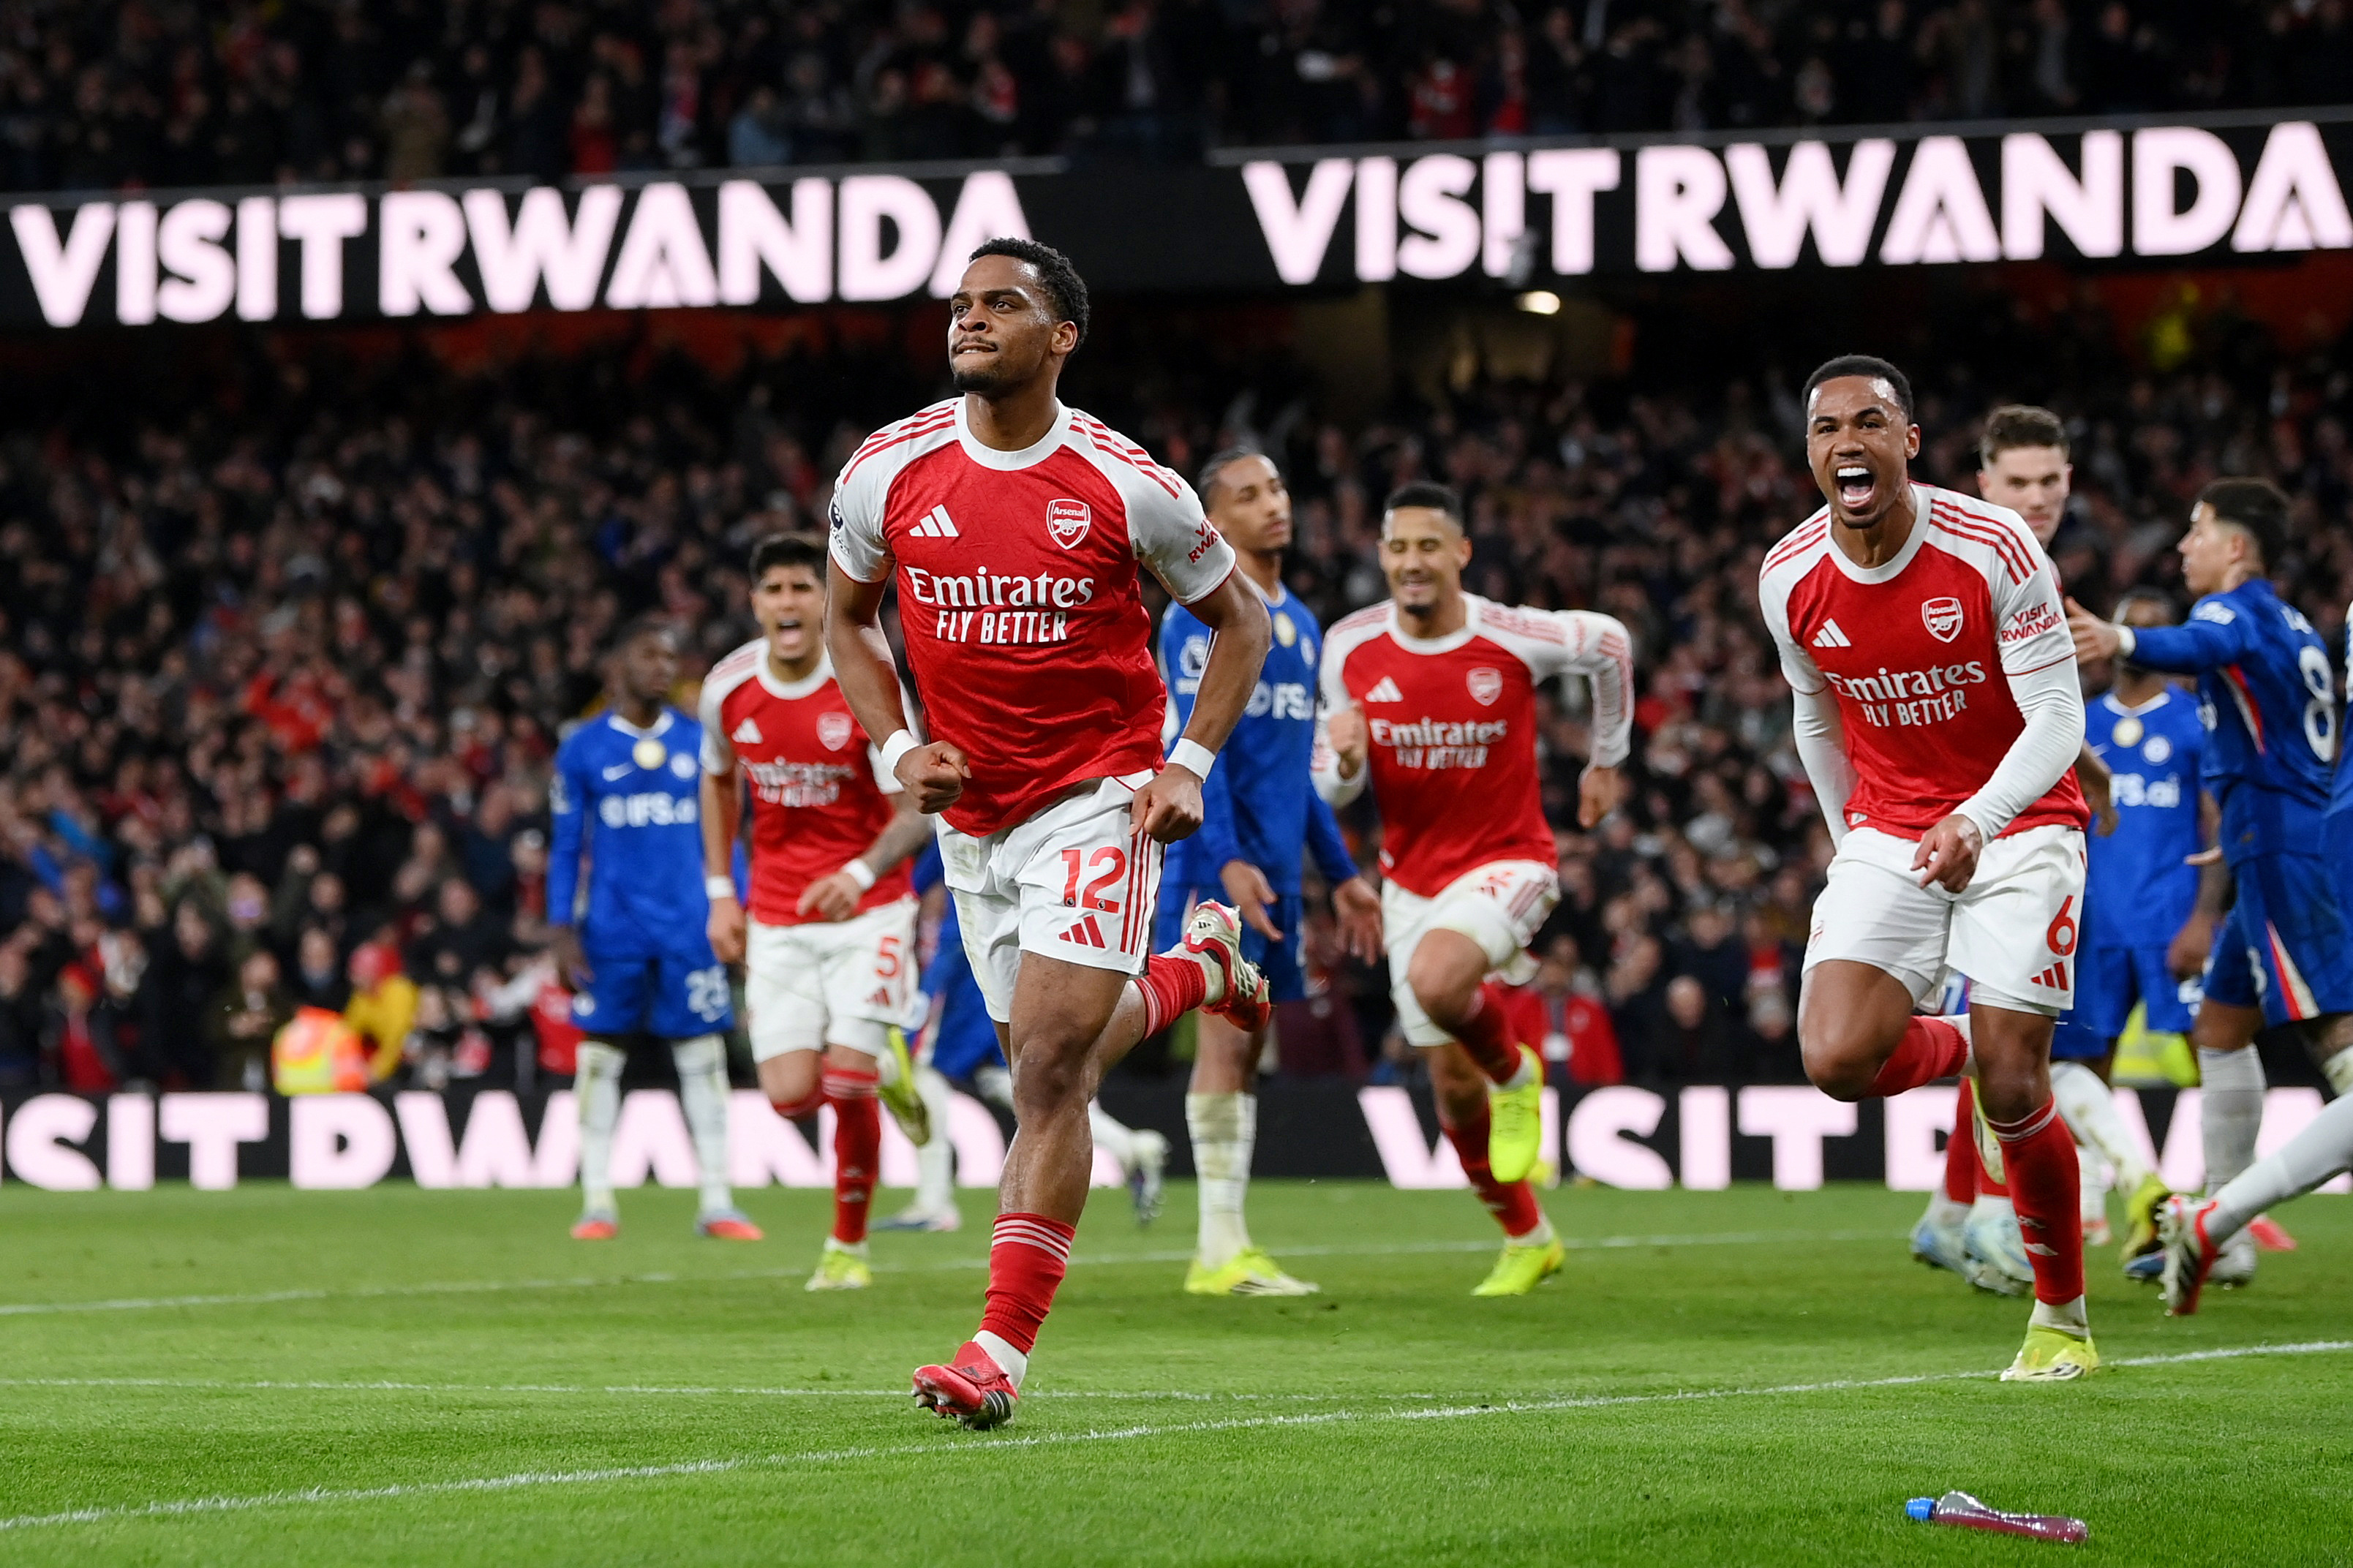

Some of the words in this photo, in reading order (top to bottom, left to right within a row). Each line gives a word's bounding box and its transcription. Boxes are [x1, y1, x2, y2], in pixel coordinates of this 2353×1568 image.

[1241, 148, 1622, 285] VISIT
[1635, 121, 2353, 272] RWANDA
[10, 192, 367, 328] VISIT
[379, 170, 1035, 317] RWANDA
[1053, 507, 1084, 516] Arsenal
[905, 565, 1094, 608] Emirates
[936, 610, 974, 643] FLY
[980, 611, 1067, 644] BETTER
[2000, 611, 2062, 642] RWANDA
[2011, 602, 2047, 625] VISIT
[1824, 660, 1987, 702] Emirates
[1895, 690, 1968, 726] BETTER
[2299, 645, 2336, 762] 8
[1061, 846, 1126, 914] 12
[2047, 895, 2076, 956] 6
[876, 935, 900, 978] 5
[0, 1092, 270, 1191] SIT
[290, 1089, 1125, 1190] RWAND
